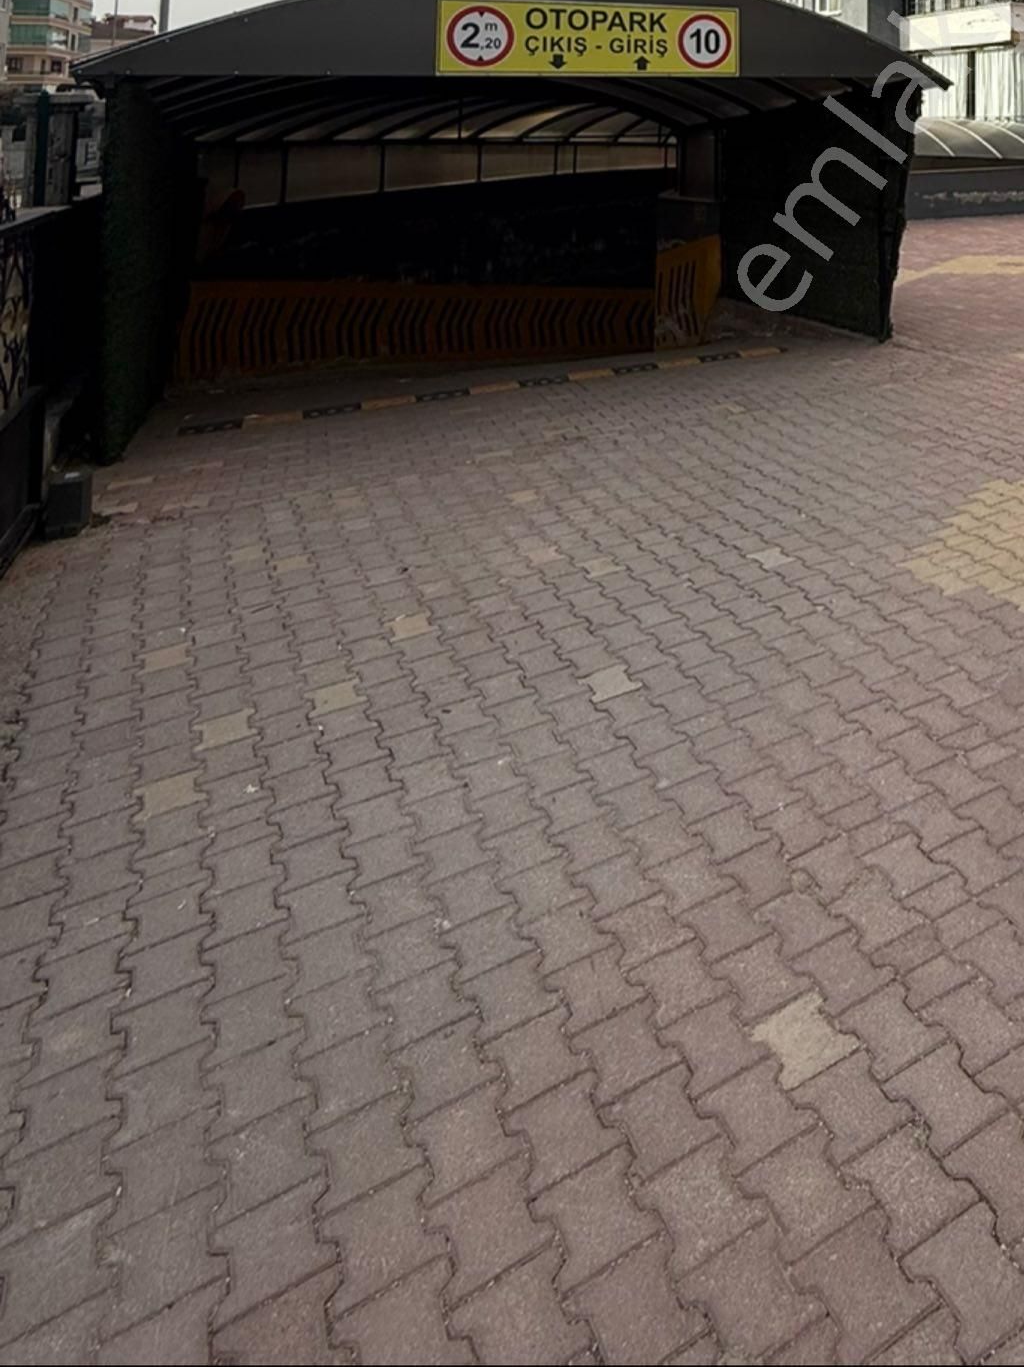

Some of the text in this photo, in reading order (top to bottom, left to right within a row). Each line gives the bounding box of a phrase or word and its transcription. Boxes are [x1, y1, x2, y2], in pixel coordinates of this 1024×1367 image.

[525, 7, 668, 33] OTOPARK
[524, 35, 588, 57] ÇIKIŞ
[608, 34, 668, 58] GİRİŞ
[689, 28, 720, 54] 10
